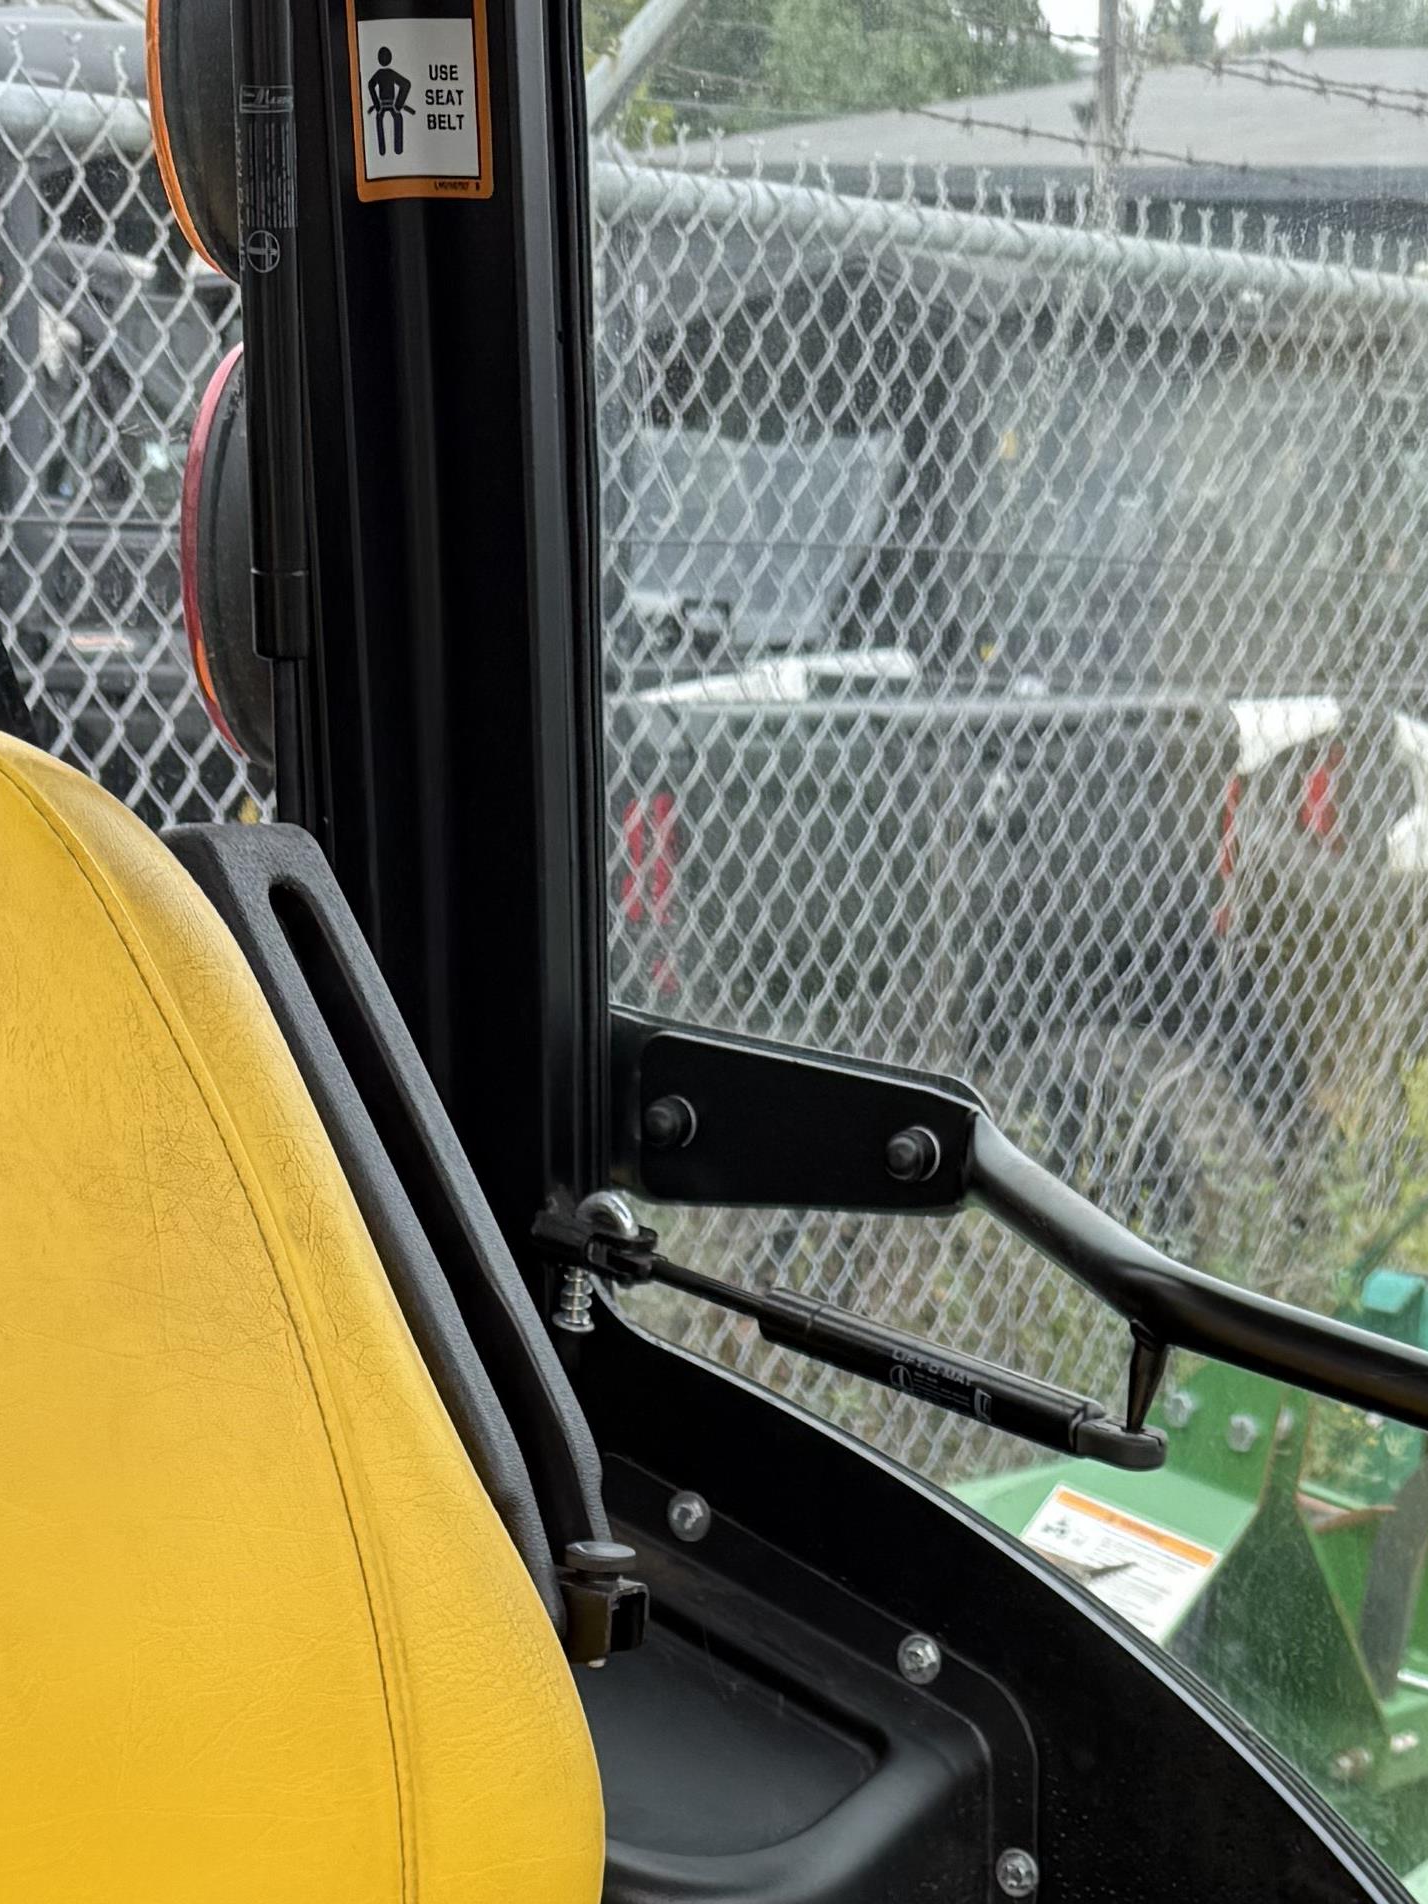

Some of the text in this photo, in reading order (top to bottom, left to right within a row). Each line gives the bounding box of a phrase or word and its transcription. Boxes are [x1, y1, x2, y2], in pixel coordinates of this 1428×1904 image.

[428, 64, 459, 81] USE
[424, 89, 464, 106] SEAT
[427, 113, 465, 130] BELT
